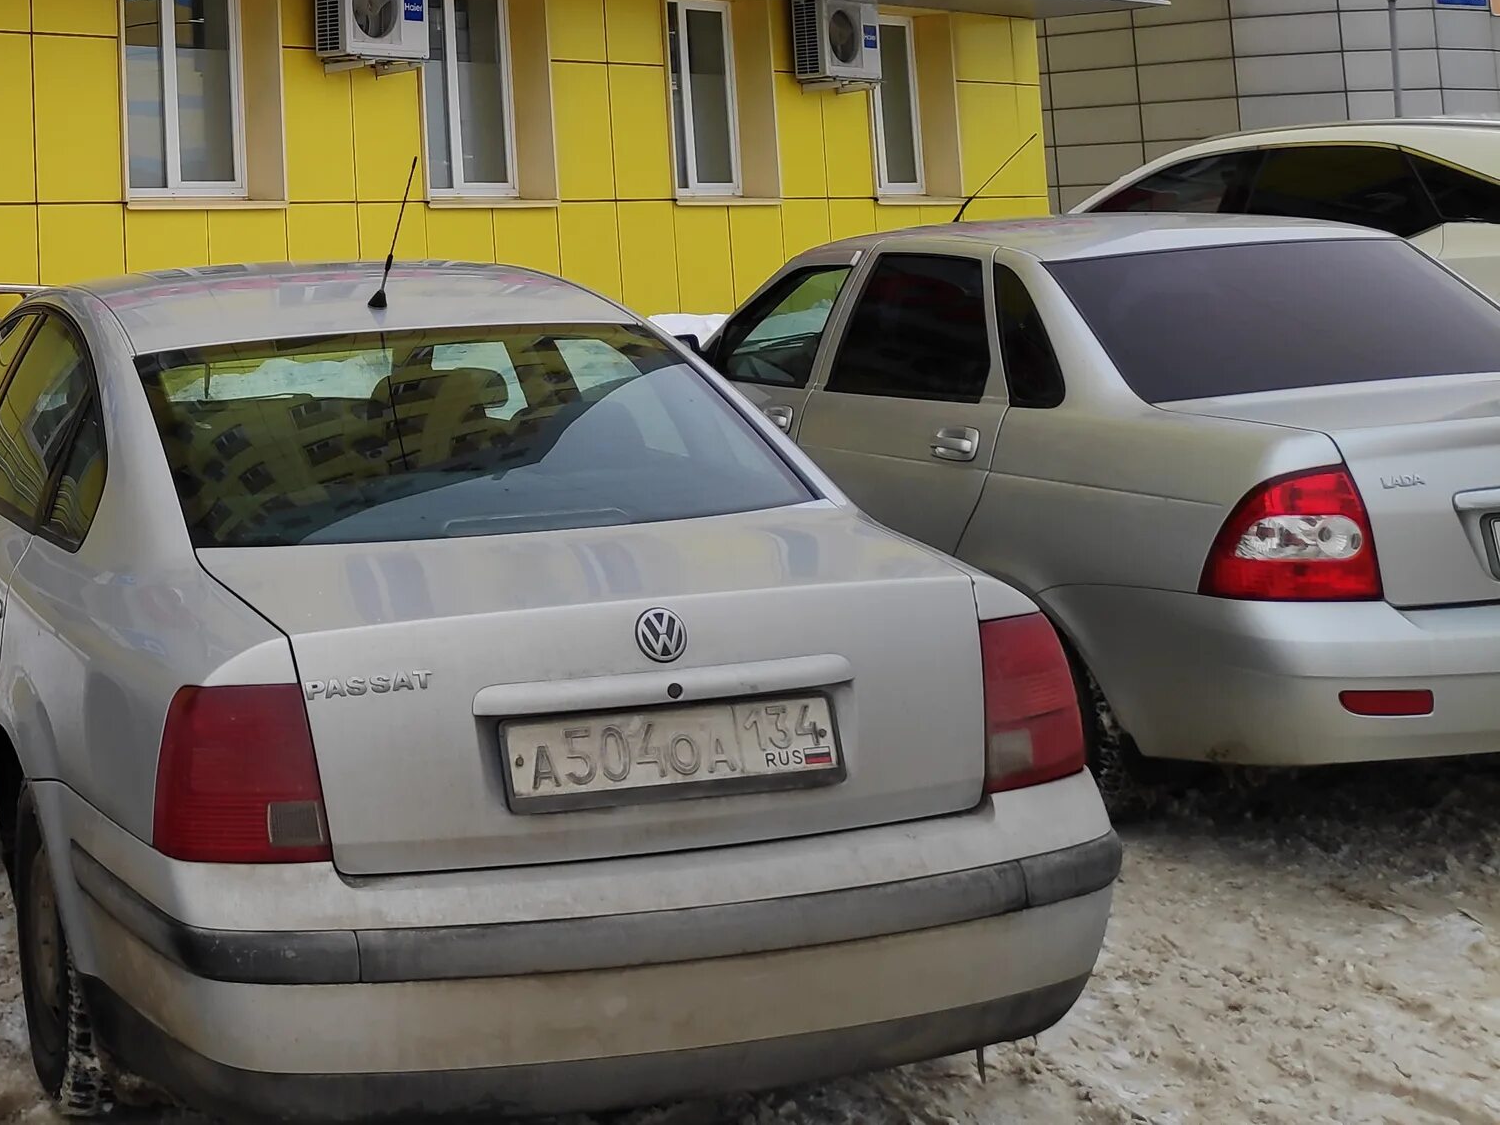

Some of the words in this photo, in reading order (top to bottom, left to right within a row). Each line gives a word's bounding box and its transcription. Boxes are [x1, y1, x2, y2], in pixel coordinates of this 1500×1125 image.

[404, 2, 422, 12] Haier
[1380, 473, 1425, 489] LADA
[304, 669, 433, 700] PASSAT
[743, 704, 821, 751] 134
[765, 749, 803, 768] RUS
